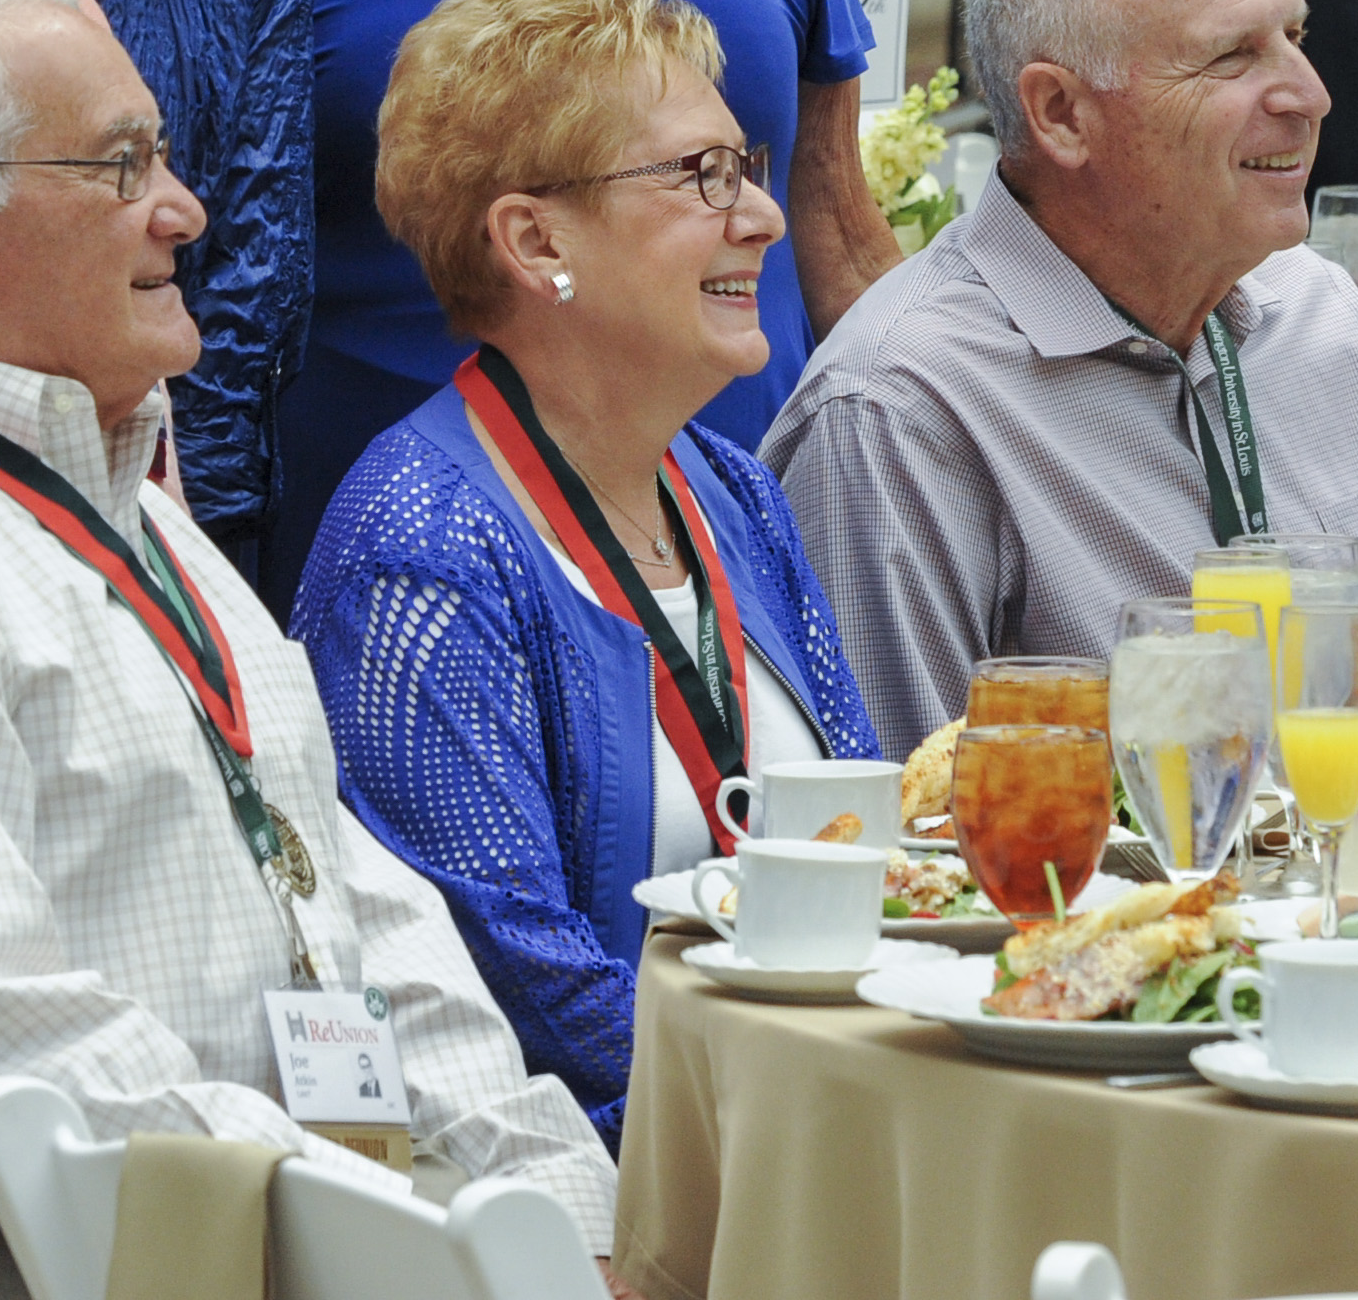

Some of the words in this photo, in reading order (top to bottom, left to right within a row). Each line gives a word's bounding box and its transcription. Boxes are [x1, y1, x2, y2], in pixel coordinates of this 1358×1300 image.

[1222, 365, 1241, 420] University
[1237, 445, 1252, 476] Louis
[701, 608, 714, 640] Louis
[289, 1052, 310, 1072] Joe
